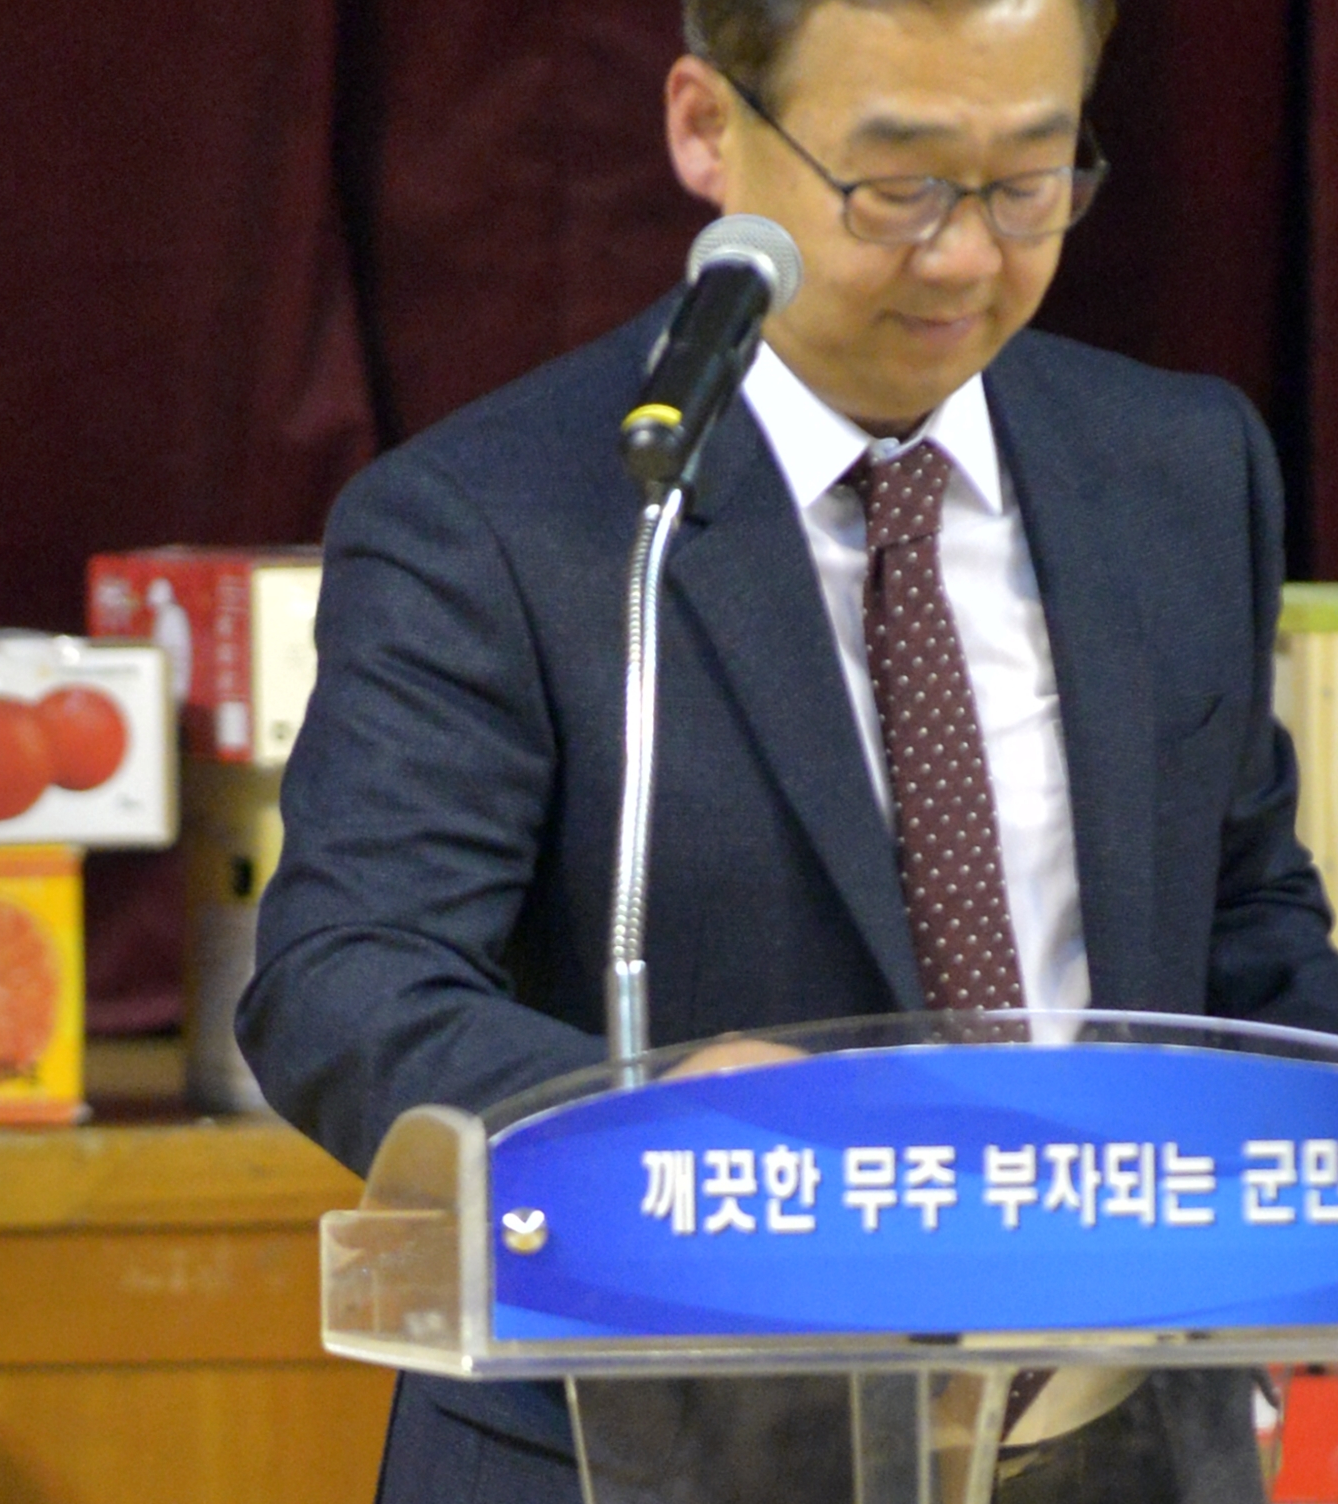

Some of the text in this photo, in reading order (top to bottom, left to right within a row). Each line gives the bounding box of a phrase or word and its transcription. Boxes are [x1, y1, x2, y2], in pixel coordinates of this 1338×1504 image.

[639, 1146, 823, 1234] 깨끗한
[843, 1145, 958, 1230] 무주
[983, 1142, 1218, 1228] 부자되는
